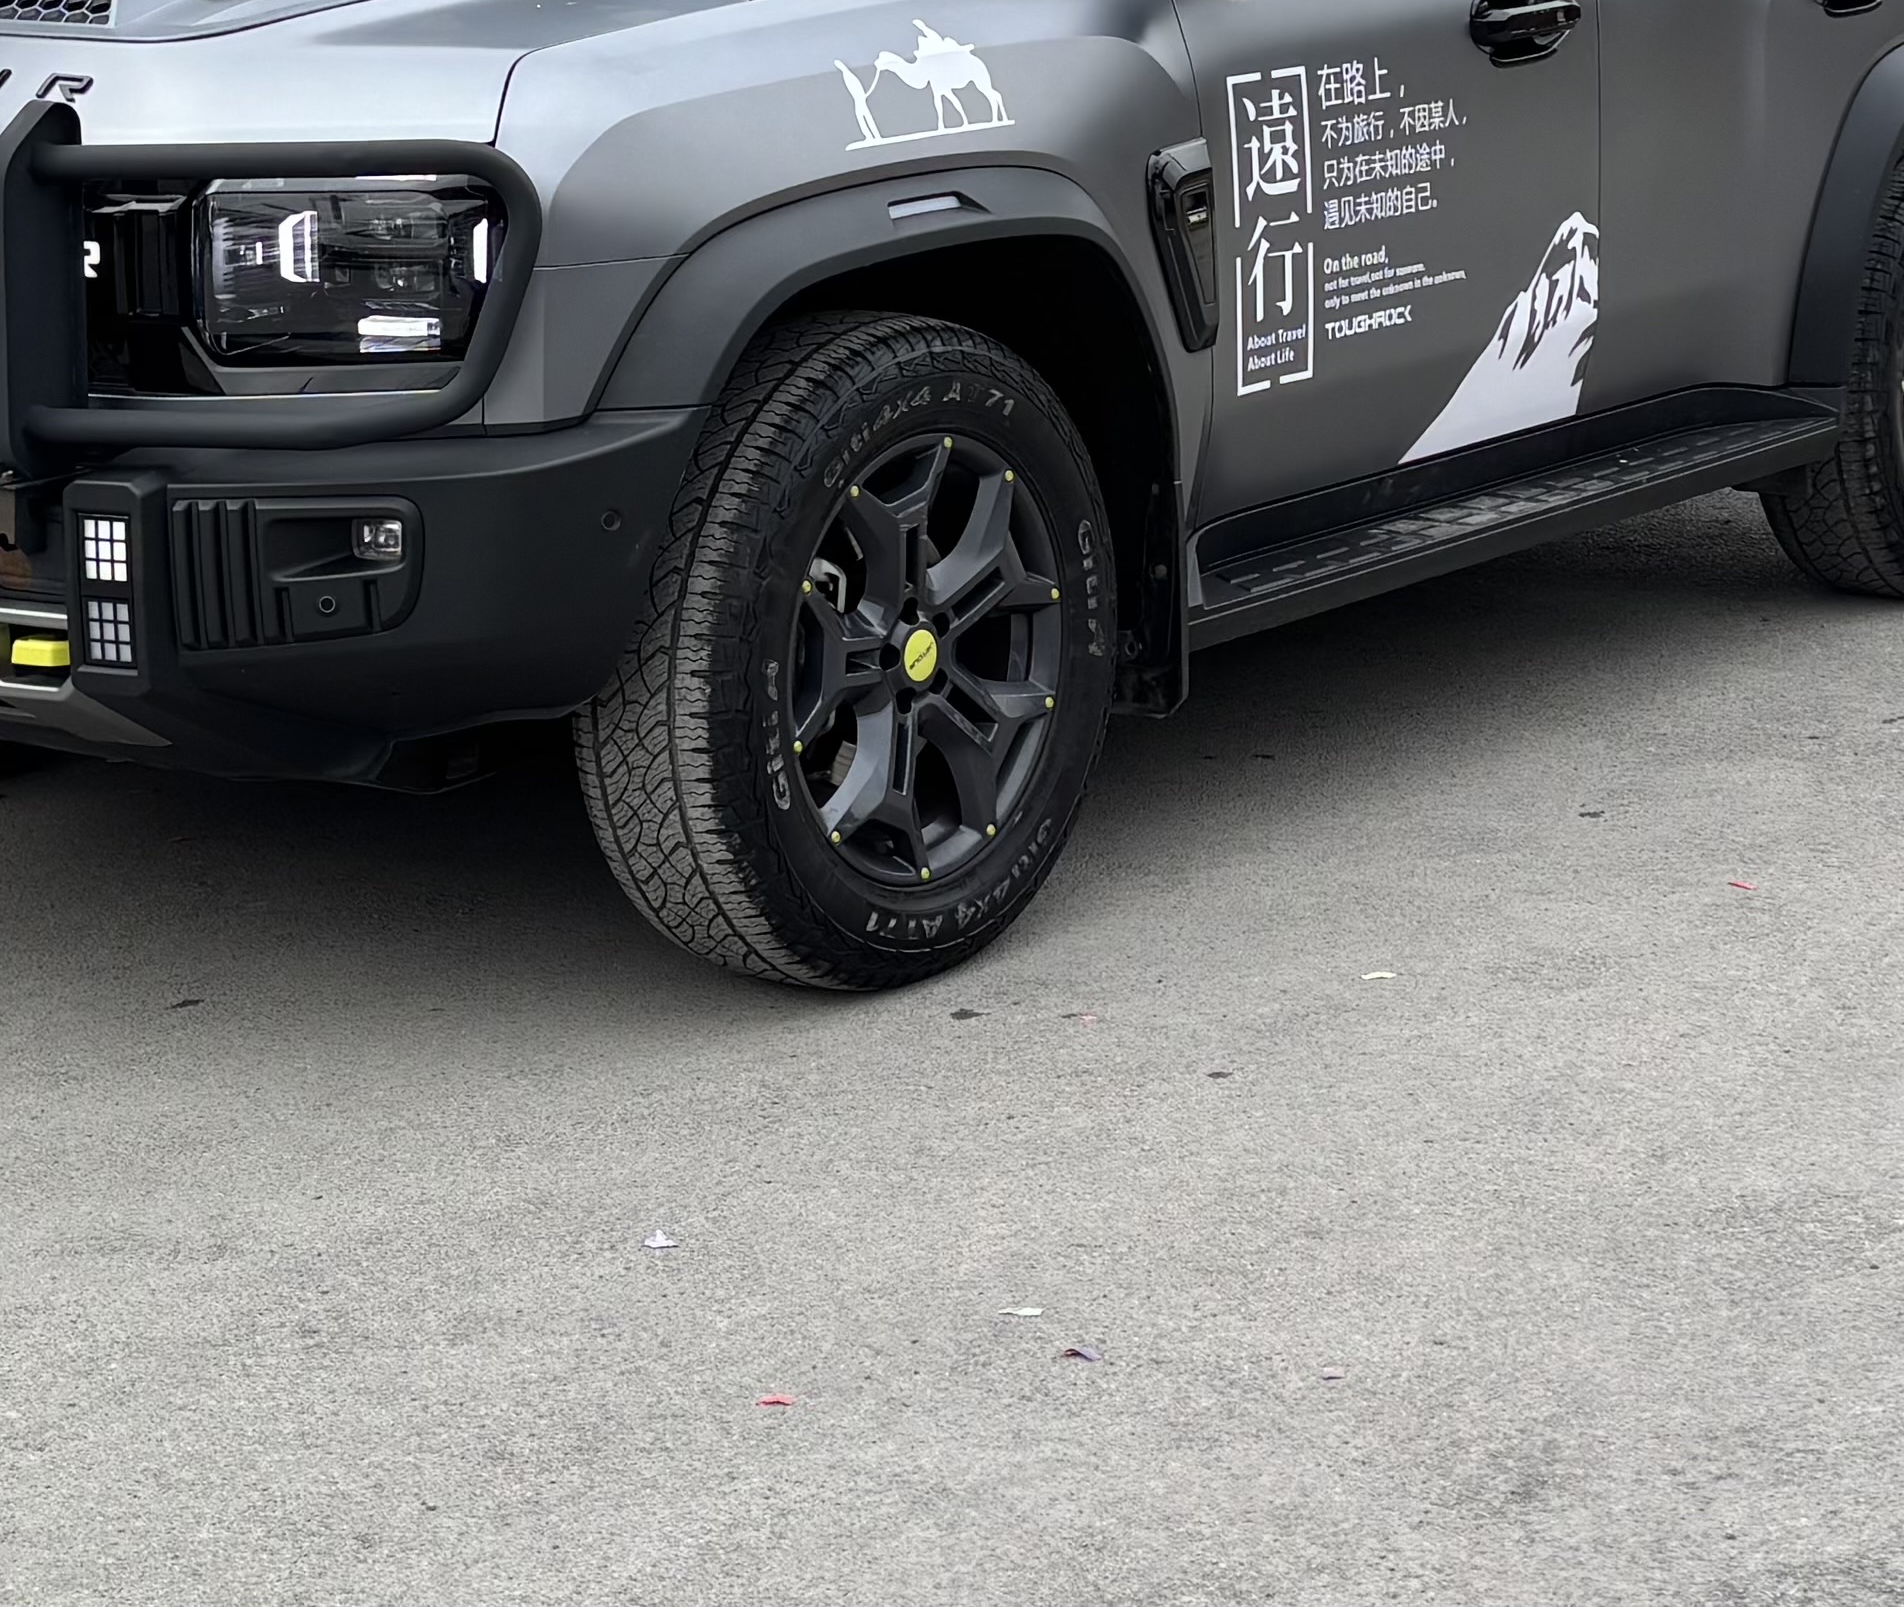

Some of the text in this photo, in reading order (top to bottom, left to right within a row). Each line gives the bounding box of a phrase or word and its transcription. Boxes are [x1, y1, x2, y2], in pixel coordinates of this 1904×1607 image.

[1323, 257, 1340, 275] On
[1341, 252, 1359, 270] the
[1247, 331, 1276, 351] About
[1247, 347, 1295, 372] About Life
